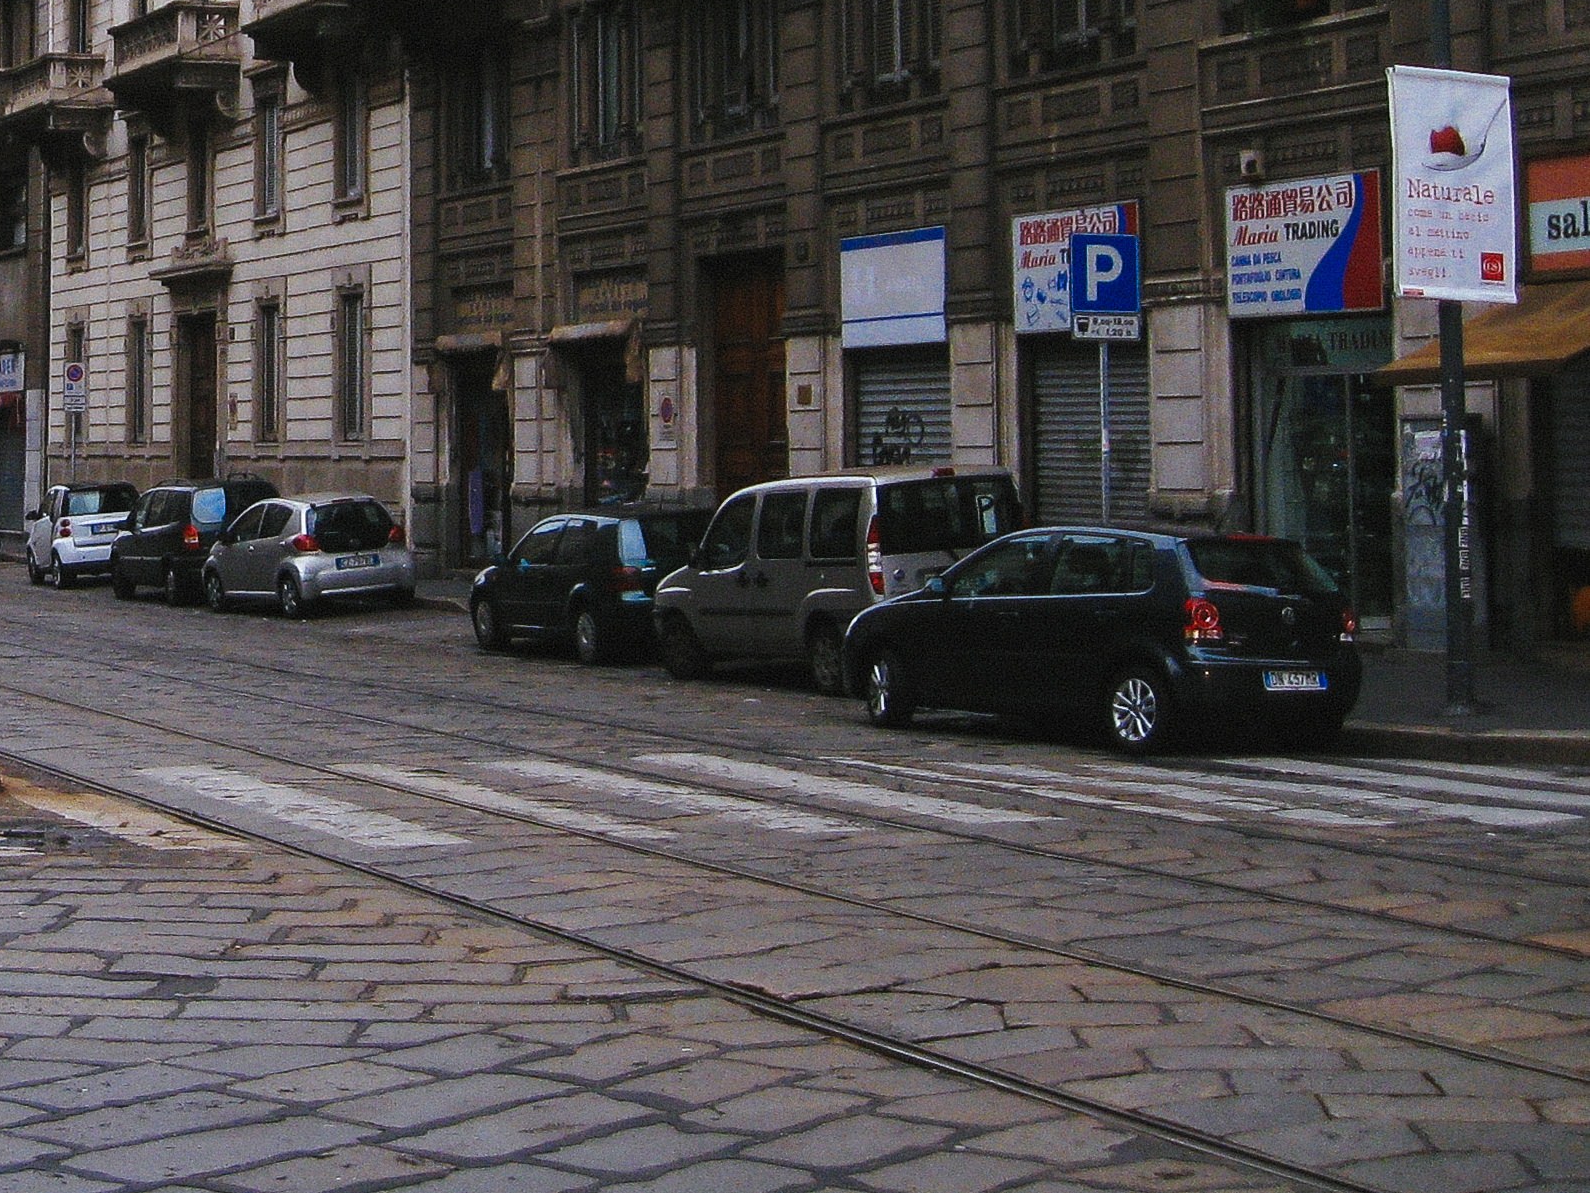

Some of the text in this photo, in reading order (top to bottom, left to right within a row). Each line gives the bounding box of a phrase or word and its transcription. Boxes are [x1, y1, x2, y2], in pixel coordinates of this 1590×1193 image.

[1407, 178, 1494, 205] Naturale
[1231, 219, 1340, 246] Maria TRADING
[1018, 249, 1056, 269] Maria
[1086, 244, 1123, 301] P
